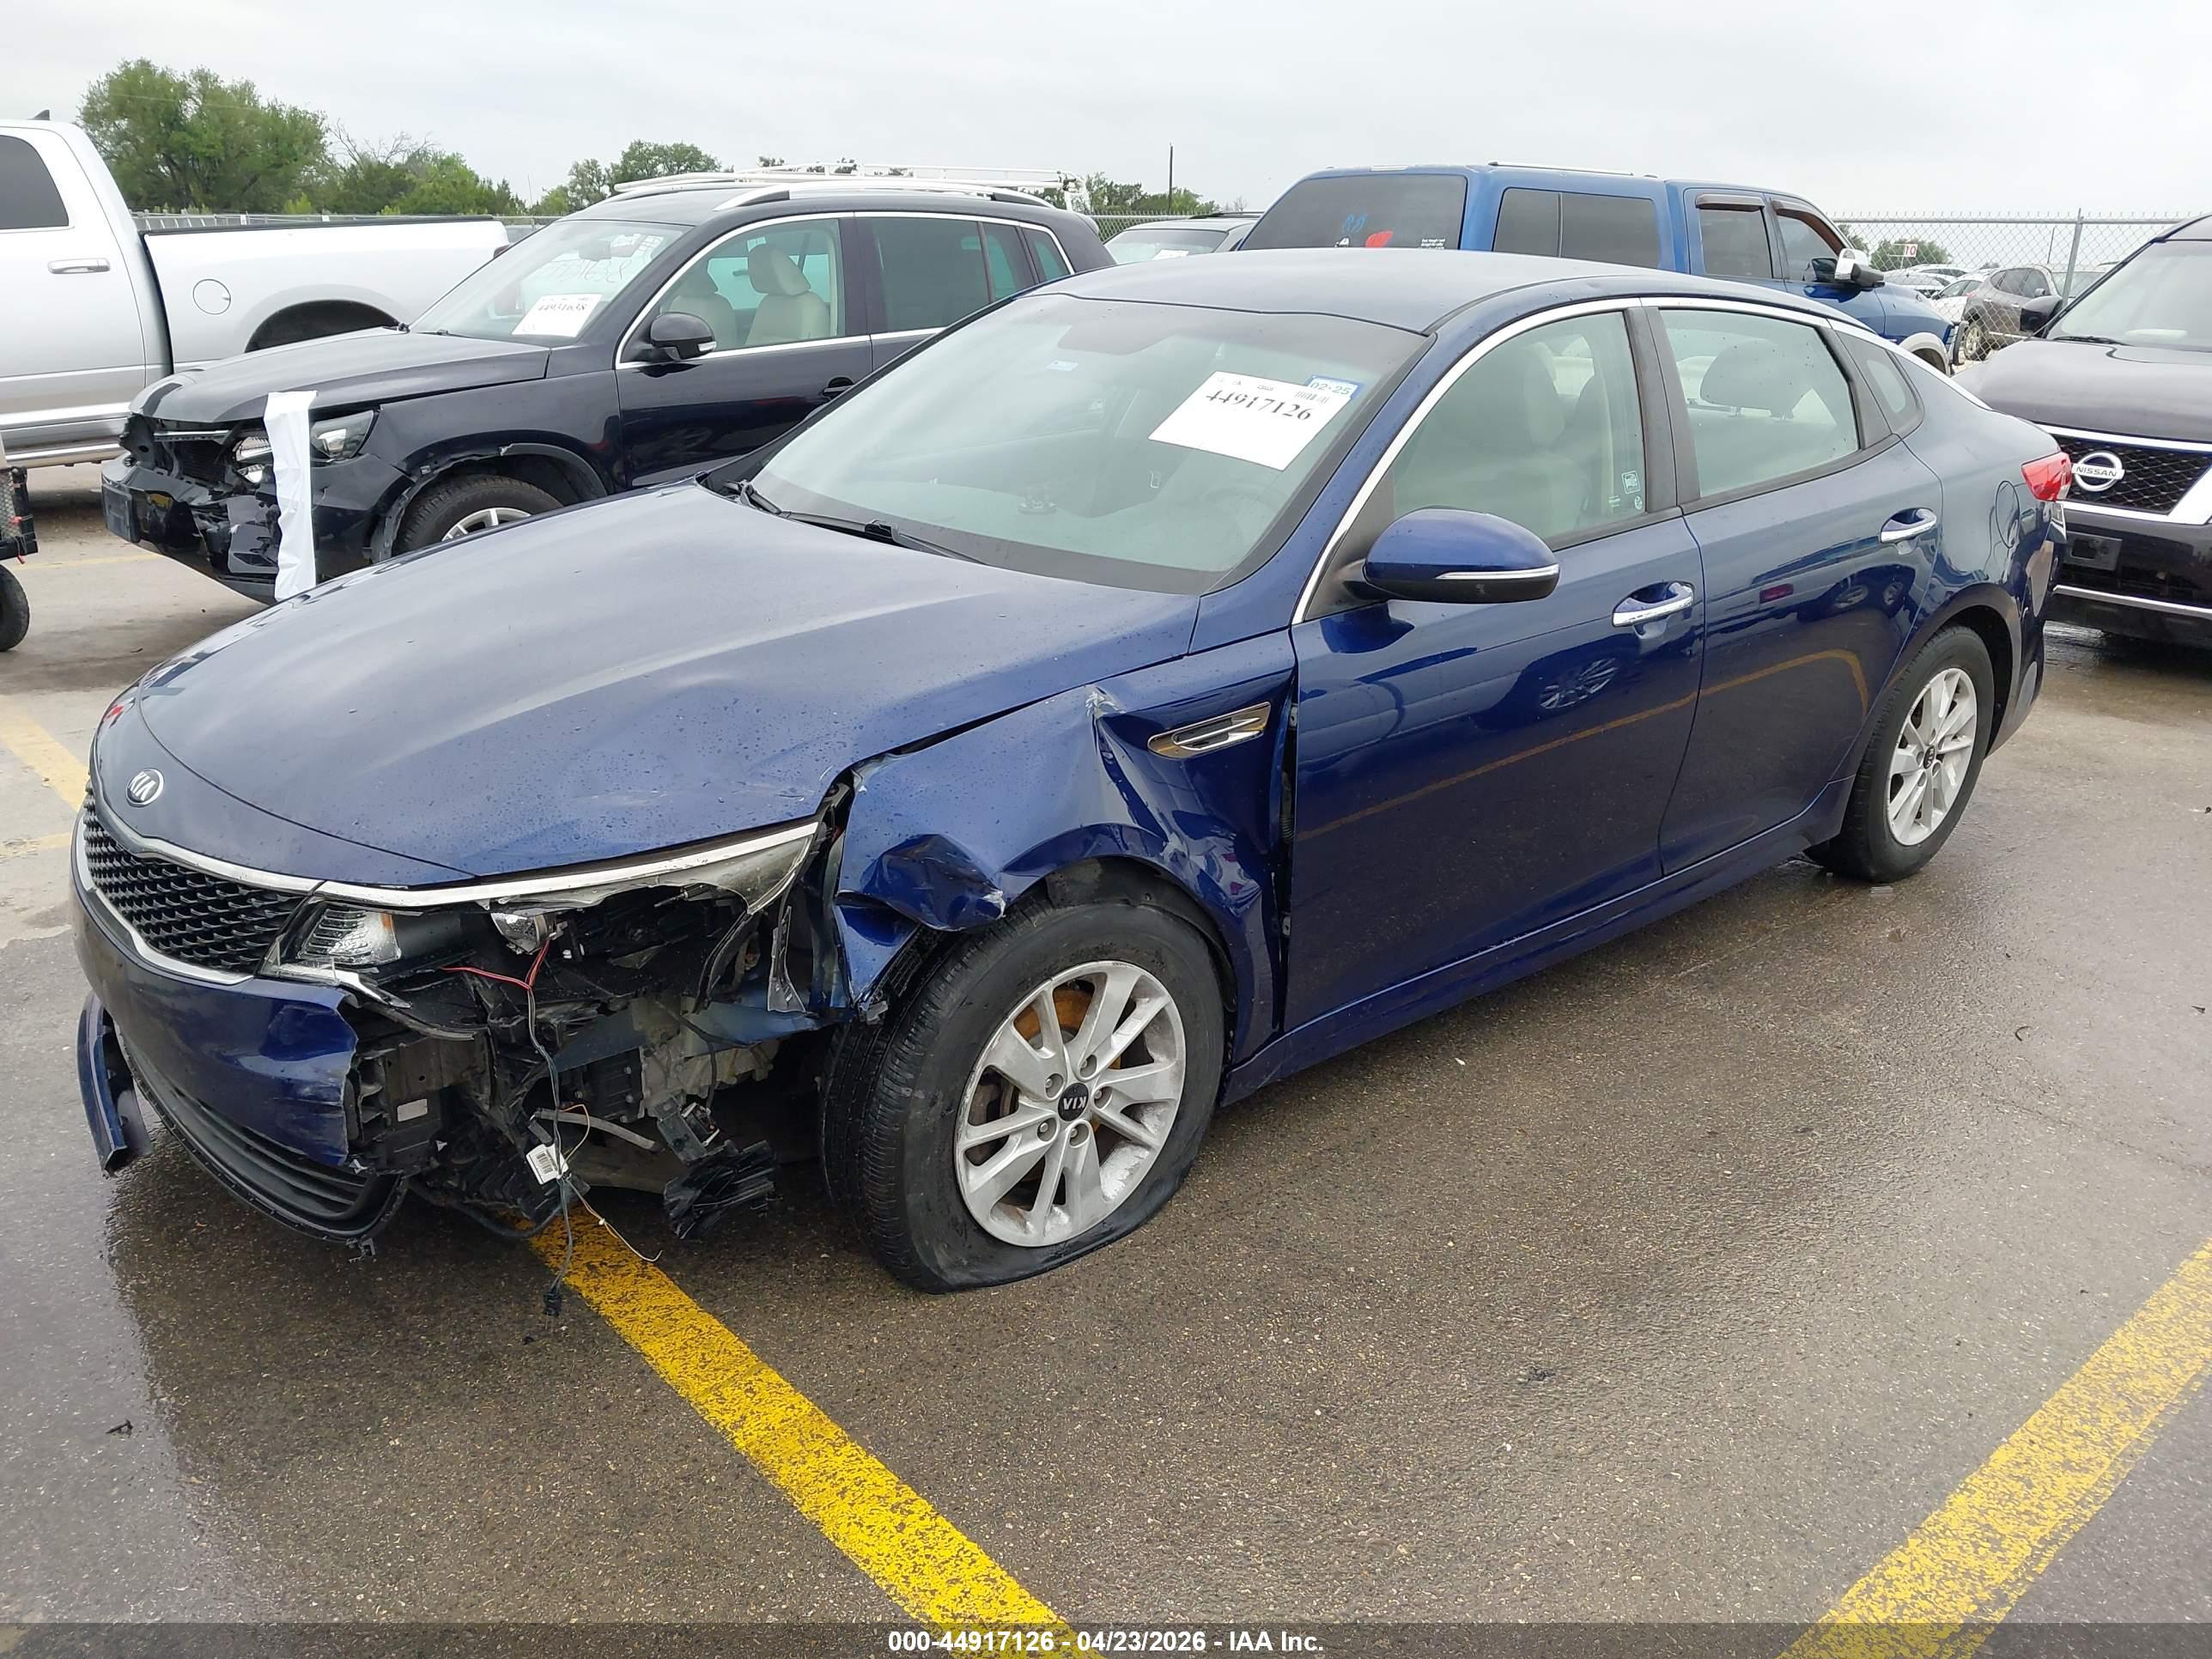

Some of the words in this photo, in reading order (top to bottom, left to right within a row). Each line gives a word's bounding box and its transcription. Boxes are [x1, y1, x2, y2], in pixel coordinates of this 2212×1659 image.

[1206, 390, 1312, 421] 44917126
[2076, 465, 2118, 477] NISSAN
[1063, 1096, 1086, 1110] KIA
